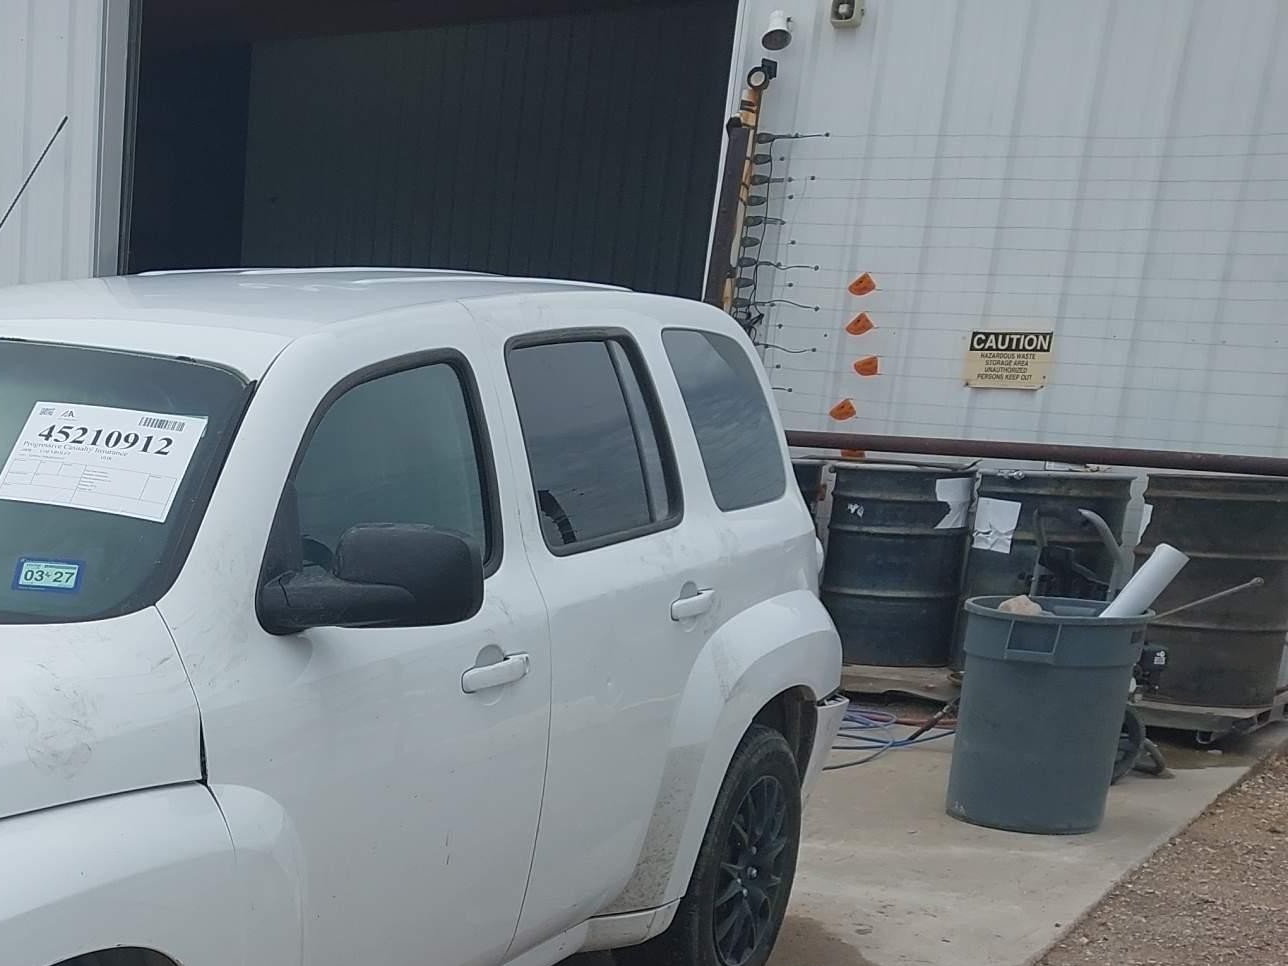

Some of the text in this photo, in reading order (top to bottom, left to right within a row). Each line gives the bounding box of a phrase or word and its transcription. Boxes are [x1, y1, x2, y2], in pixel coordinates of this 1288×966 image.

[973, 334, 1050, 350] CAUTION
[38, 424, 173, 456] 45210912
[24, 569, 75, 583] 03 27
